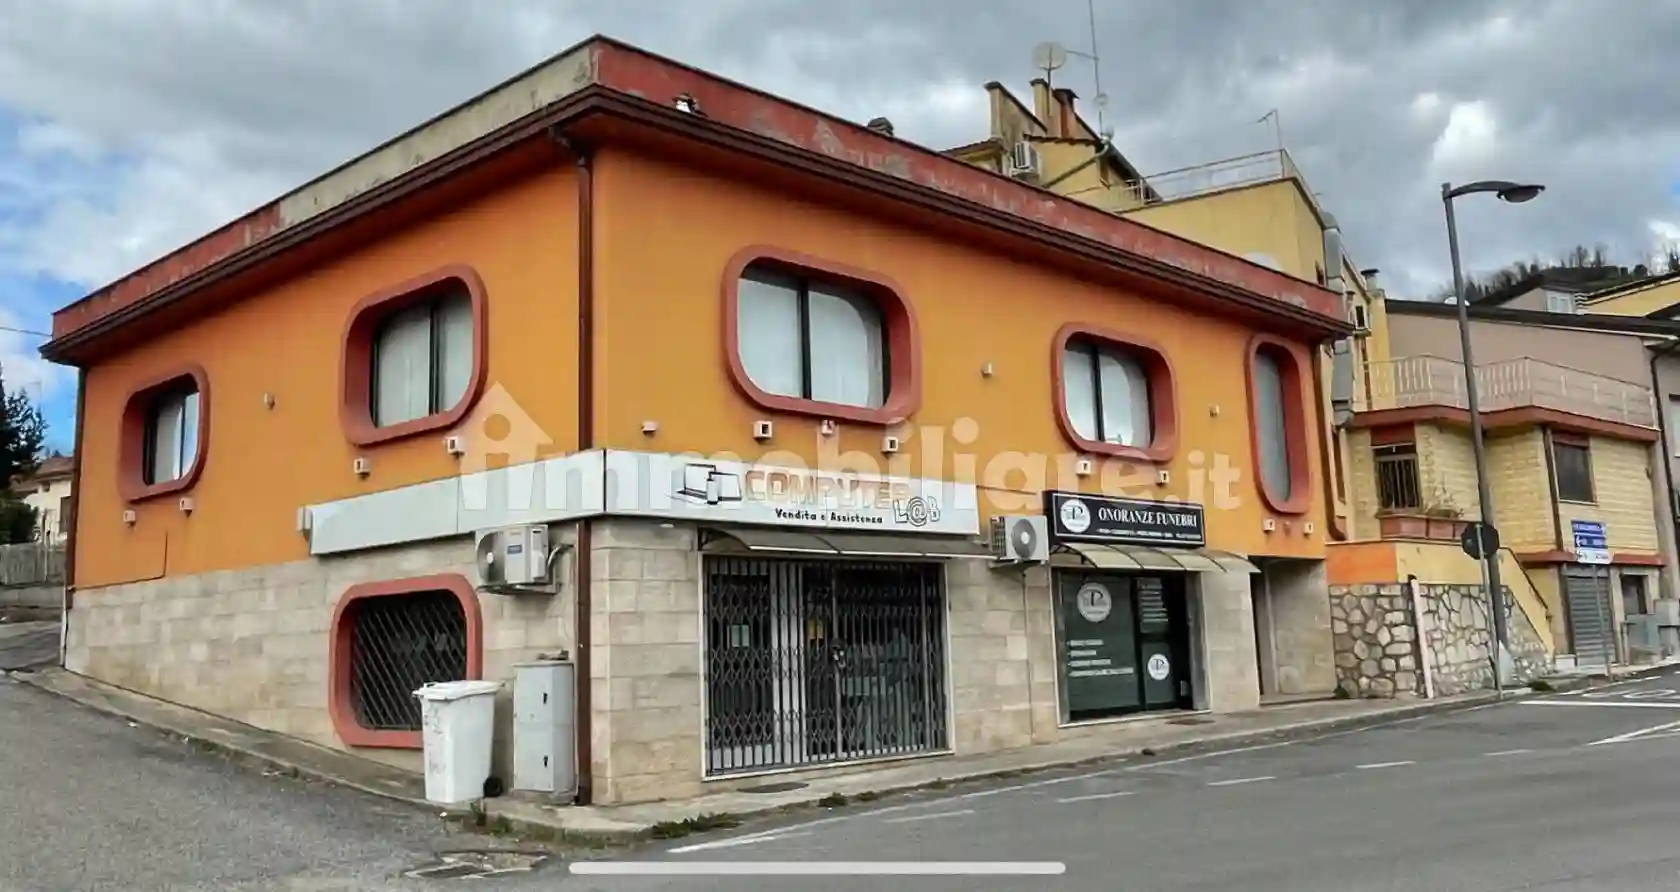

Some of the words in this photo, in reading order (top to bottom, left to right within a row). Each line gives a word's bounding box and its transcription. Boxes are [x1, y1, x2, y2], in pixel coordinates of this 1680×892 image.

[745, 469, 910, 509] COMPUTER
[775, 506, 817, 521] Vendita
[829, 510, 884, 525] Assistenza
[892, 495, 942, 528] L@B
[1098, 507, 1155, 525] ONORANZE
[1156, 511, 1198, 528] FUNEBRI
